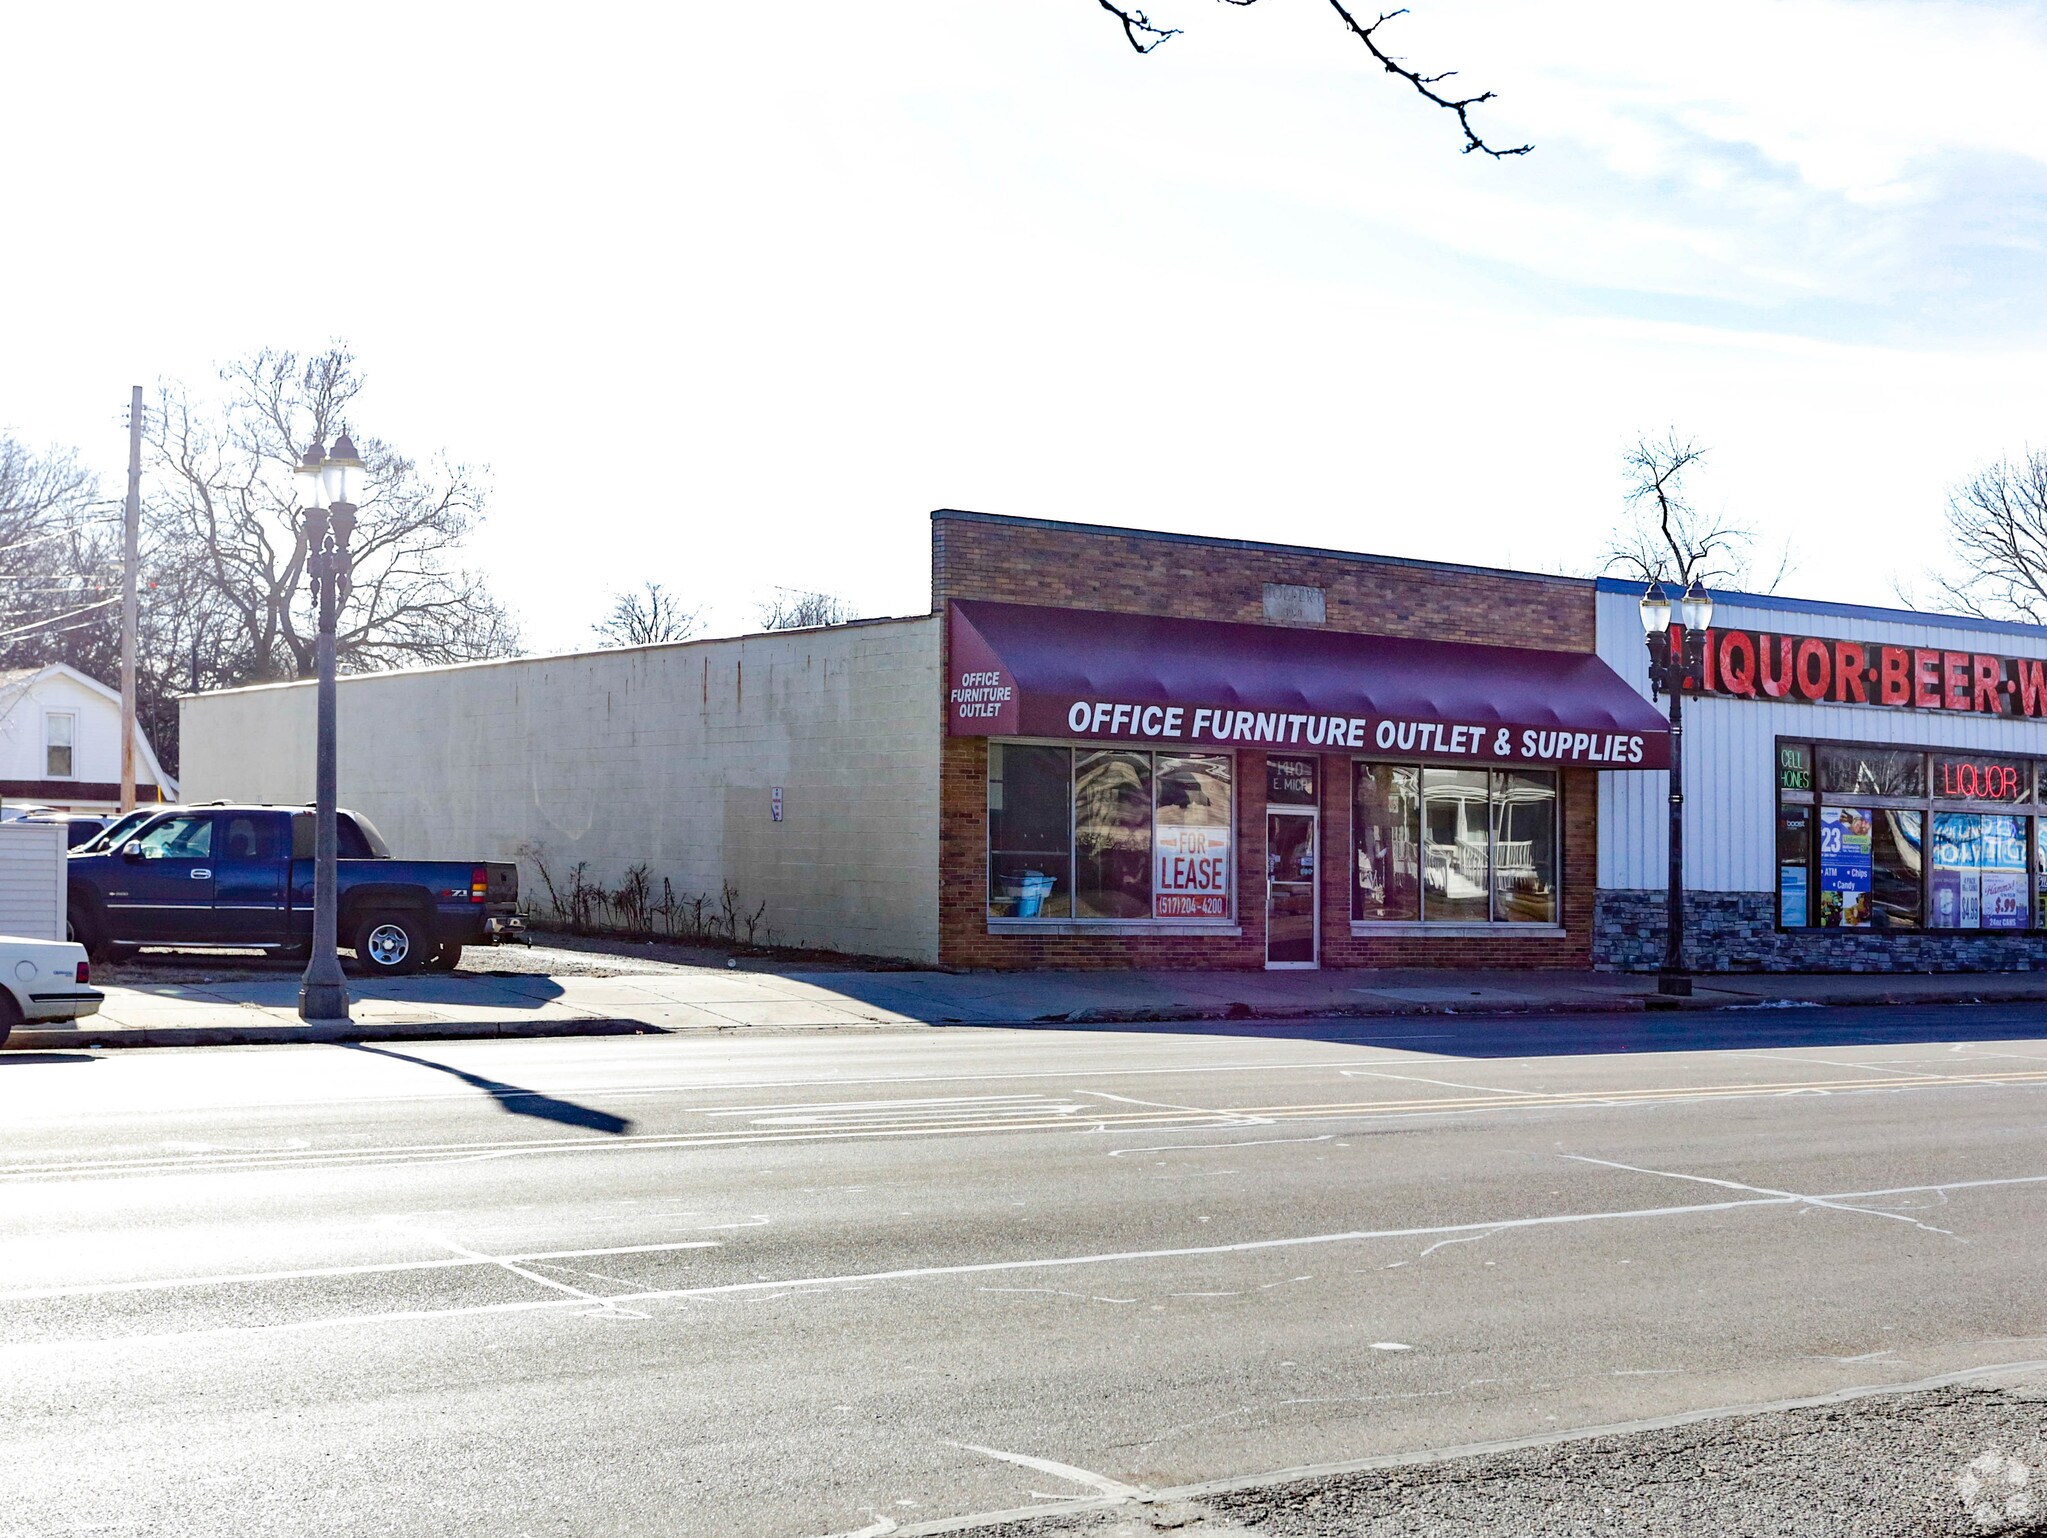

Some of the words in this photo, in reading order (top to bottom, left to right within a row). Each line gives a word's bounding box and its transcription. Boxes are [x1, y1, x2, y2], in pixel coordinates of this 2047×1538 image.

[962, 671, 1000, 687] OFFICE
[1881, 646, 2003, 713] BEER
[951, 686, 1012, 703] FURNITURE
[960, 702, 1001, 718] OUTLET
[1068, 701, 1184, 737] OFFICE
[1191, 708, 1367, 747] FURNITURE
[1375, 720, 1486, 754] OUTLET
[1493, 727, 1511, 756] &
[1520, 729, 1644, 763] SUPPLIES
[1781, 750, 1803, 769] CELL
[1273, 777, 1282, 790] E.
[1781, 770, 1810, 789] HONES
[1944, 763, 2017, 798] LIQUOR
[1180, 832, 1206, 854] FOR
[1161, 857, 1223, 889] LEASE
[1824, 867, 1838, 876] ATM
[1851, 868, 1868, 879] Chips
[1837, 881, 1855, 890] Candy
